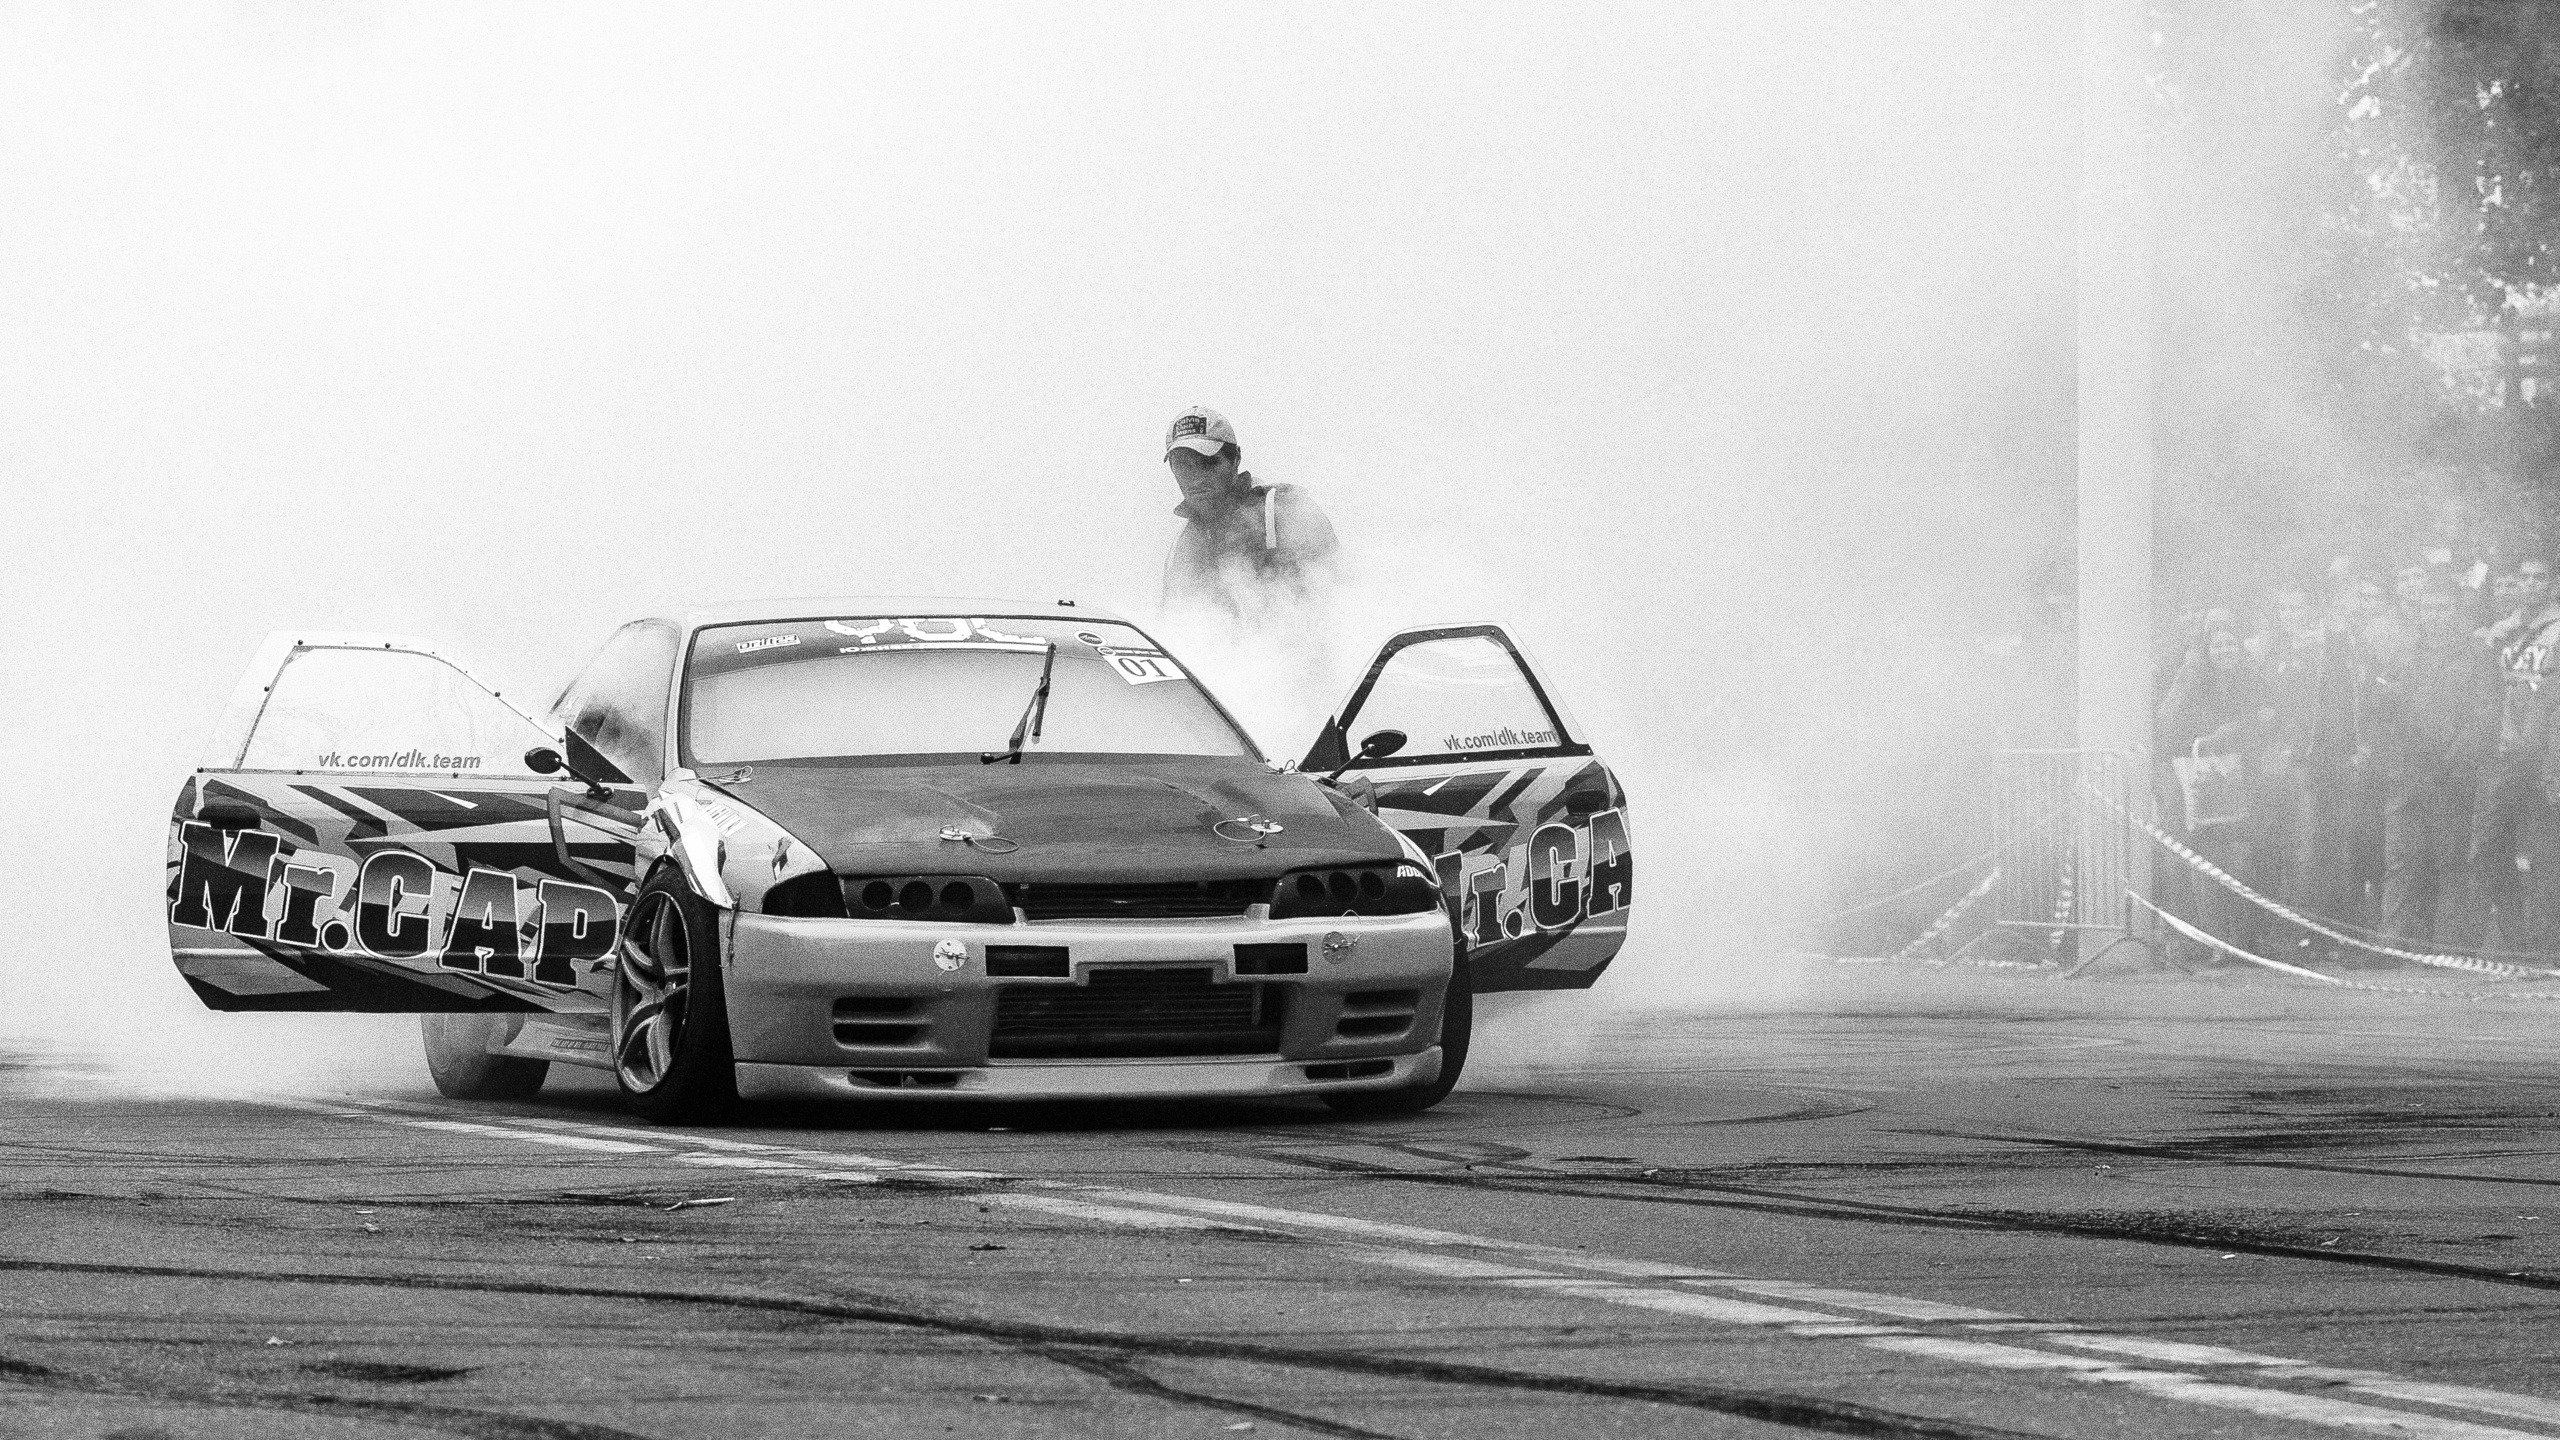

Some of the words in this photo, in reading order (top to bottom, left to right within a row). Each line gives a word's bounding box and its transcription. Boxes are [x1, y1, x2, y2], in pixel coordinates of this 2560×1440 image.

[1117, 657, 1172, 678] 01
[1443, 726, 1557, 750] vk.com/dlk.team
[318, 749, 481, 769] vk.com/dlk.team
[170, 819, 622, 988] Mr.CAP
